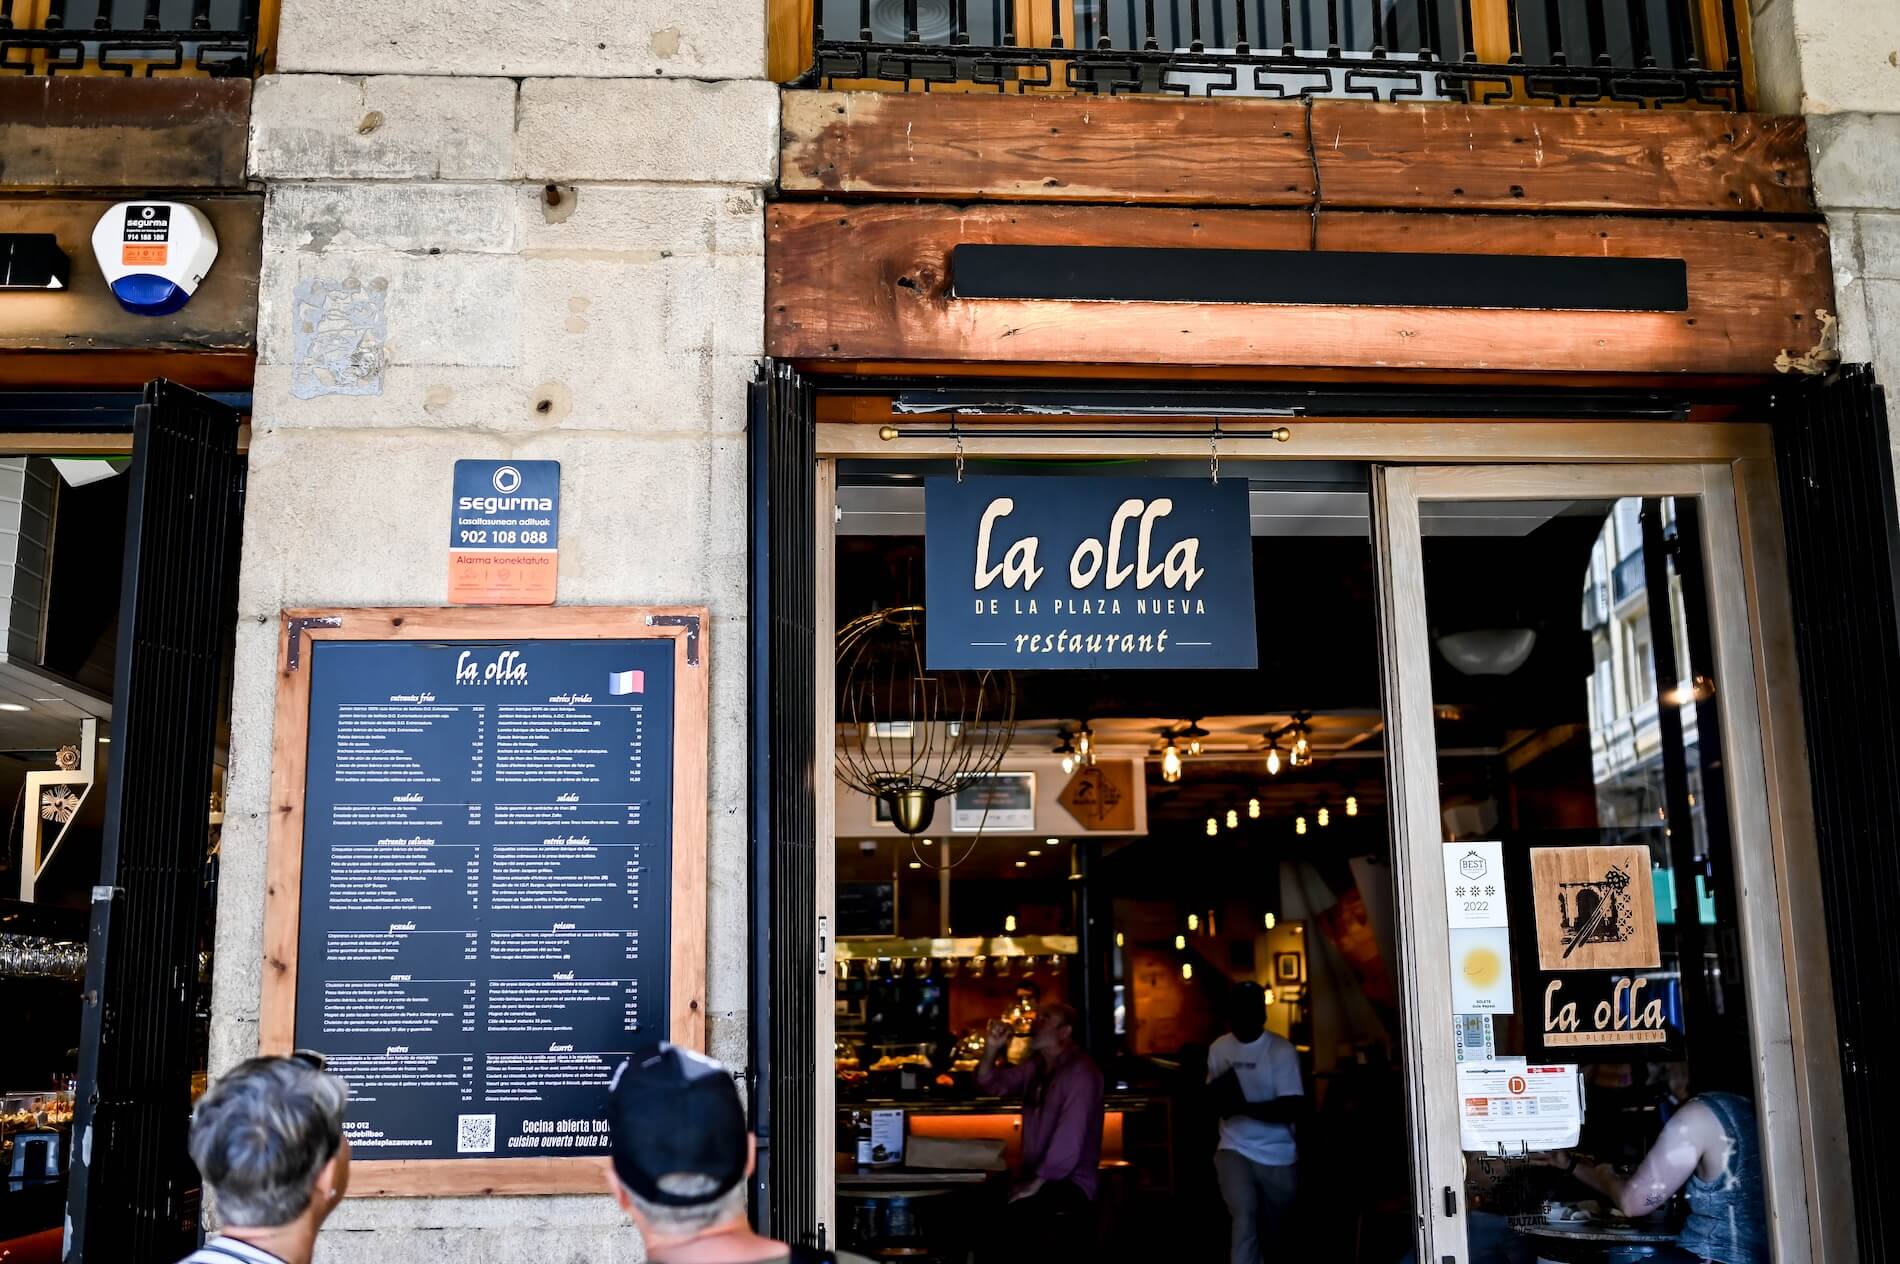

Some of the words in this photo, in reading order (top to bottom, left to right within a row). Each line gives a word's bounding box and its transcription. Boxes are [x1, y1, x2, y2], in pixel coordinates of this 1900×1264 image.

[127, 219, 168, 228] segurma
[459, 496, 552, 514] segurma
[460, 530, 486, 544] 902
[492, 530, 516, 544] 108
[520, 531, 548, 544] 088
[974, 496, 1044, 591] la
[1069, 498, 1204, 592] olla
[456, 556, 492, 565] Alarma
[975, 599, 999, 614] DE
[1015, 599, 1039, 614] LA
[1054, 600, 1121, 614] PLAZA
[1137, 600, 1206, 614] NUEVA
[1014, 628, 1169, 654] restaurant
[456, 650, 479, 680] la
[484, 650, 528, 680] olla
[1462, 860, 1484, 868] BEST
[1464, 901, 1488, 911] 2022
[1544, 979, 1580, 1031] la
[1594, 978, 1666, 1031] olla
[1629, 1032, 1665, 1041] NUEVA
[1512, 1078, 1524, 1092] D
[522, 1119, 554, 1133] Cocina
[556, 1119, 589, 1133] abierta
[508, 1135, 540, 1147] cuisine
[541, 1135, 573, 1147] ouverte
[575, 1135, 598, 1147] toute
[599, 1134, 608, 1147] la
